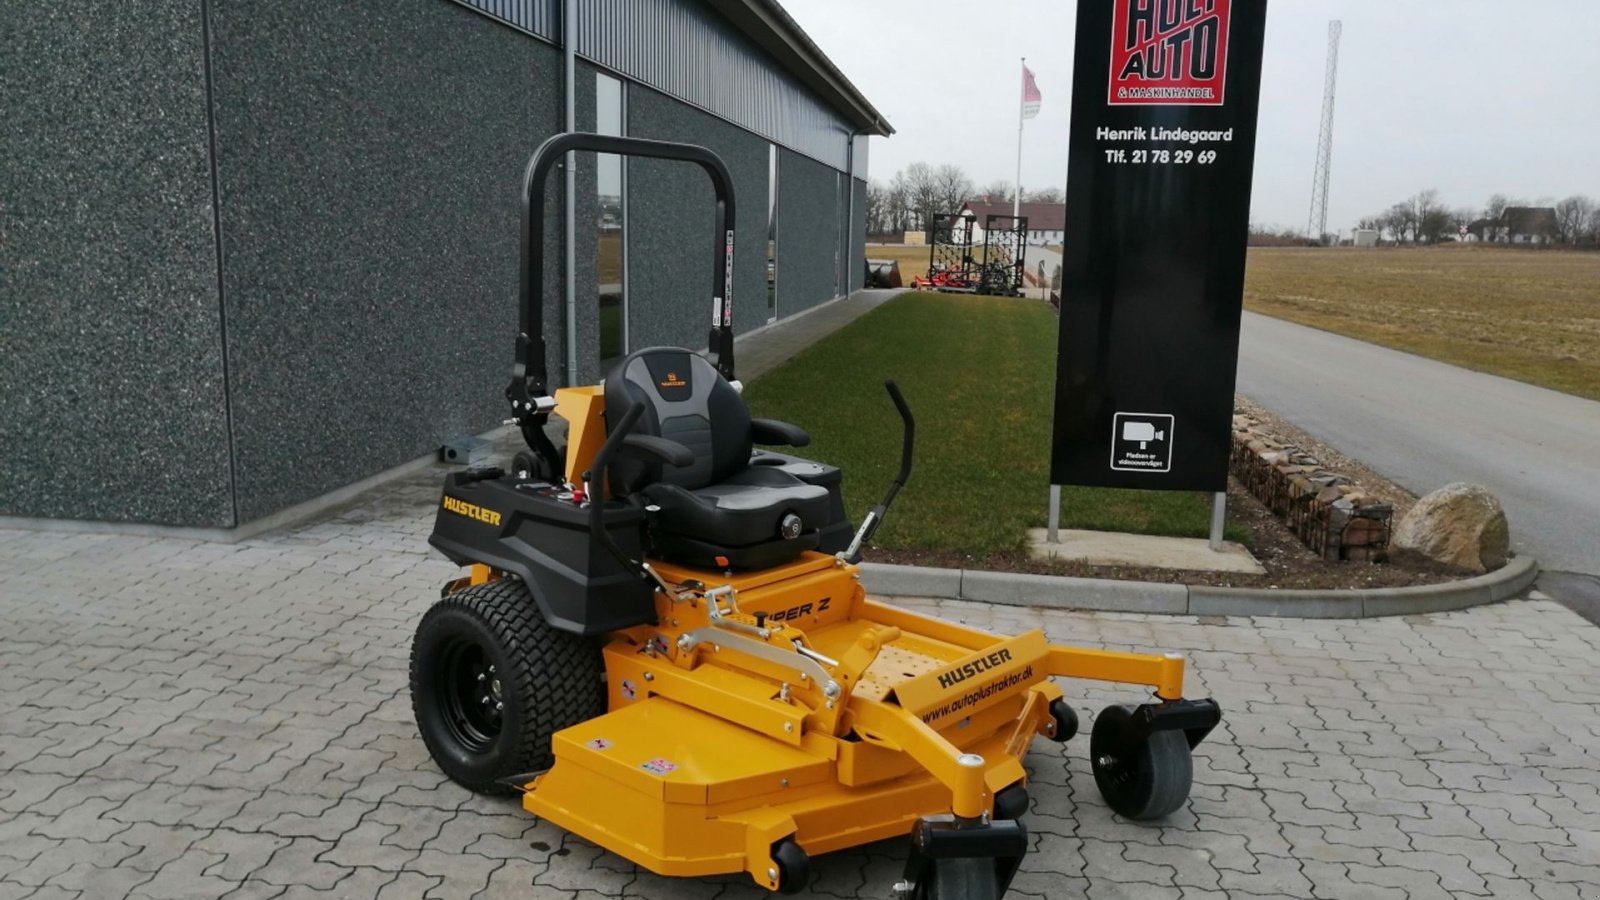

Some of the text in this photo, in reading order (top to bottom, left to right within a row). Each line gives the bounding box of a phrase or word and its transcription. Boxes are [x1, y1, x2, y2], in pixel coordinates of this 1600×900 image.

[1118, 14, 1219, 81] AUTO
[1118, 87, 1214, 99] & MASKINHANDEL
[1096, 127, 1233, 143] Henrik Lindegaard
[1105, 150, 1217, 164] Tlf. 21 78 29 69
[443, 495, 502, 526] HUSTLER
[817, 597, 831, 611] Z
[937, 648, 1012, 689] HUSTLER
[922, 665, 1034, 724] www.autoplustraktor.dk
